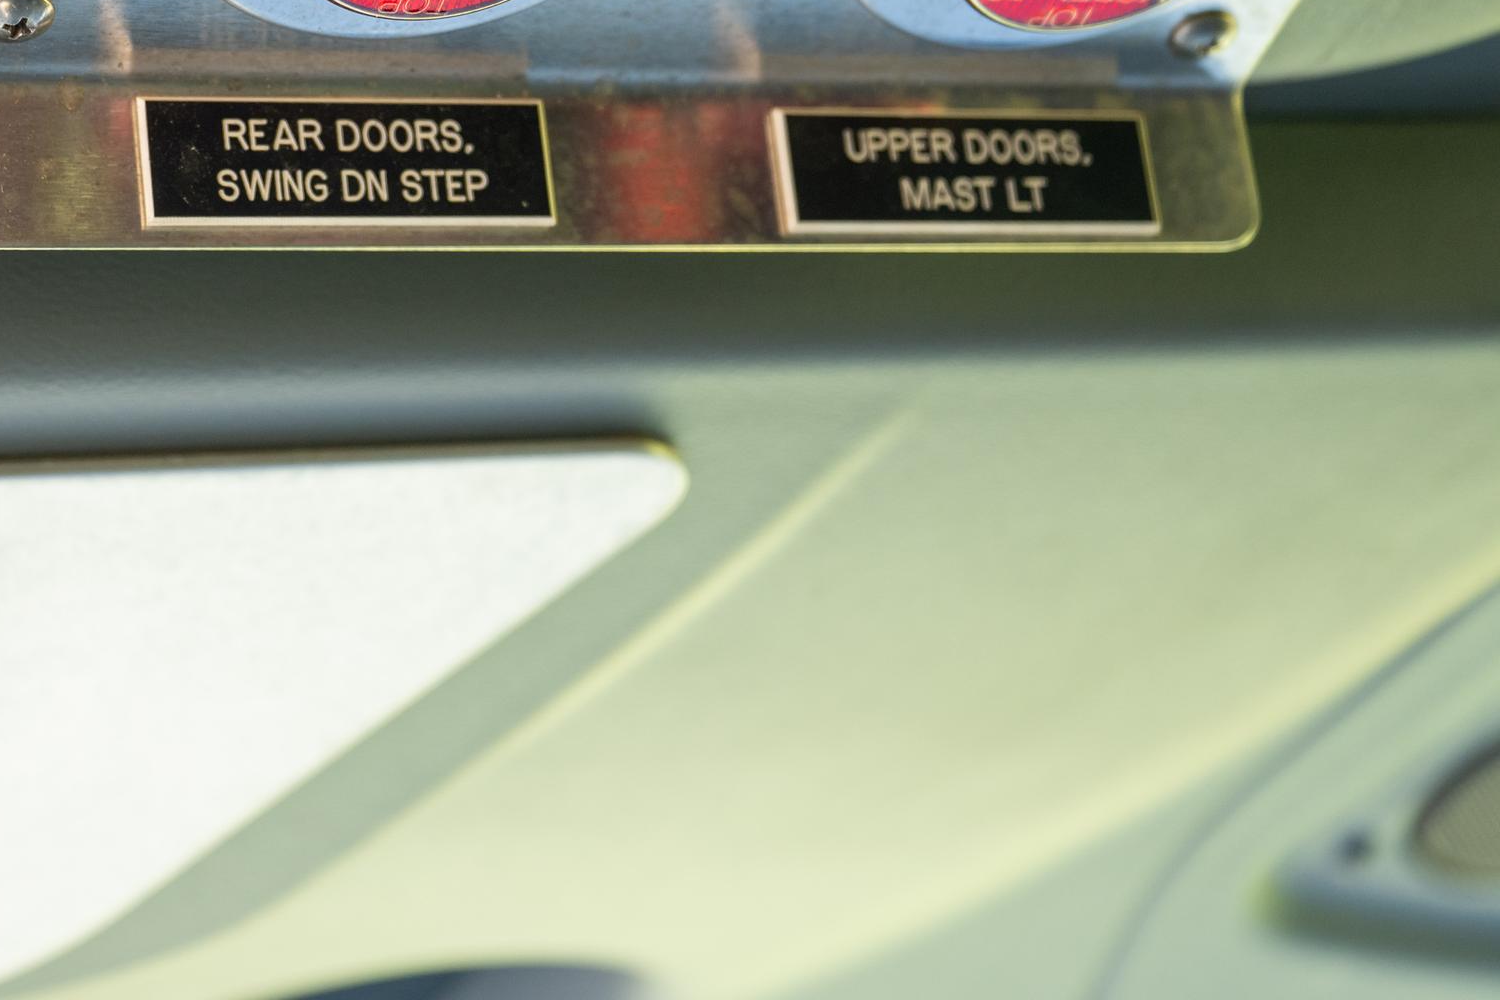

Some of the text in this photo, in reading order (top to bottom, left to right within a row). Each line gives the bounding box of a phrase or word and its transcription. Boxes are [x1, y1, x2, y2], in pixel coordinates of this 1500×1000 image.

[1027, 6, 1094, 27] TOP
[221, 118, 325, 152] REAR
[843, 128, 956, 163] UPPER
[216, 168, 489, 203] SWING DN STEP
[900, 176, 1047, 212] MAST LT
